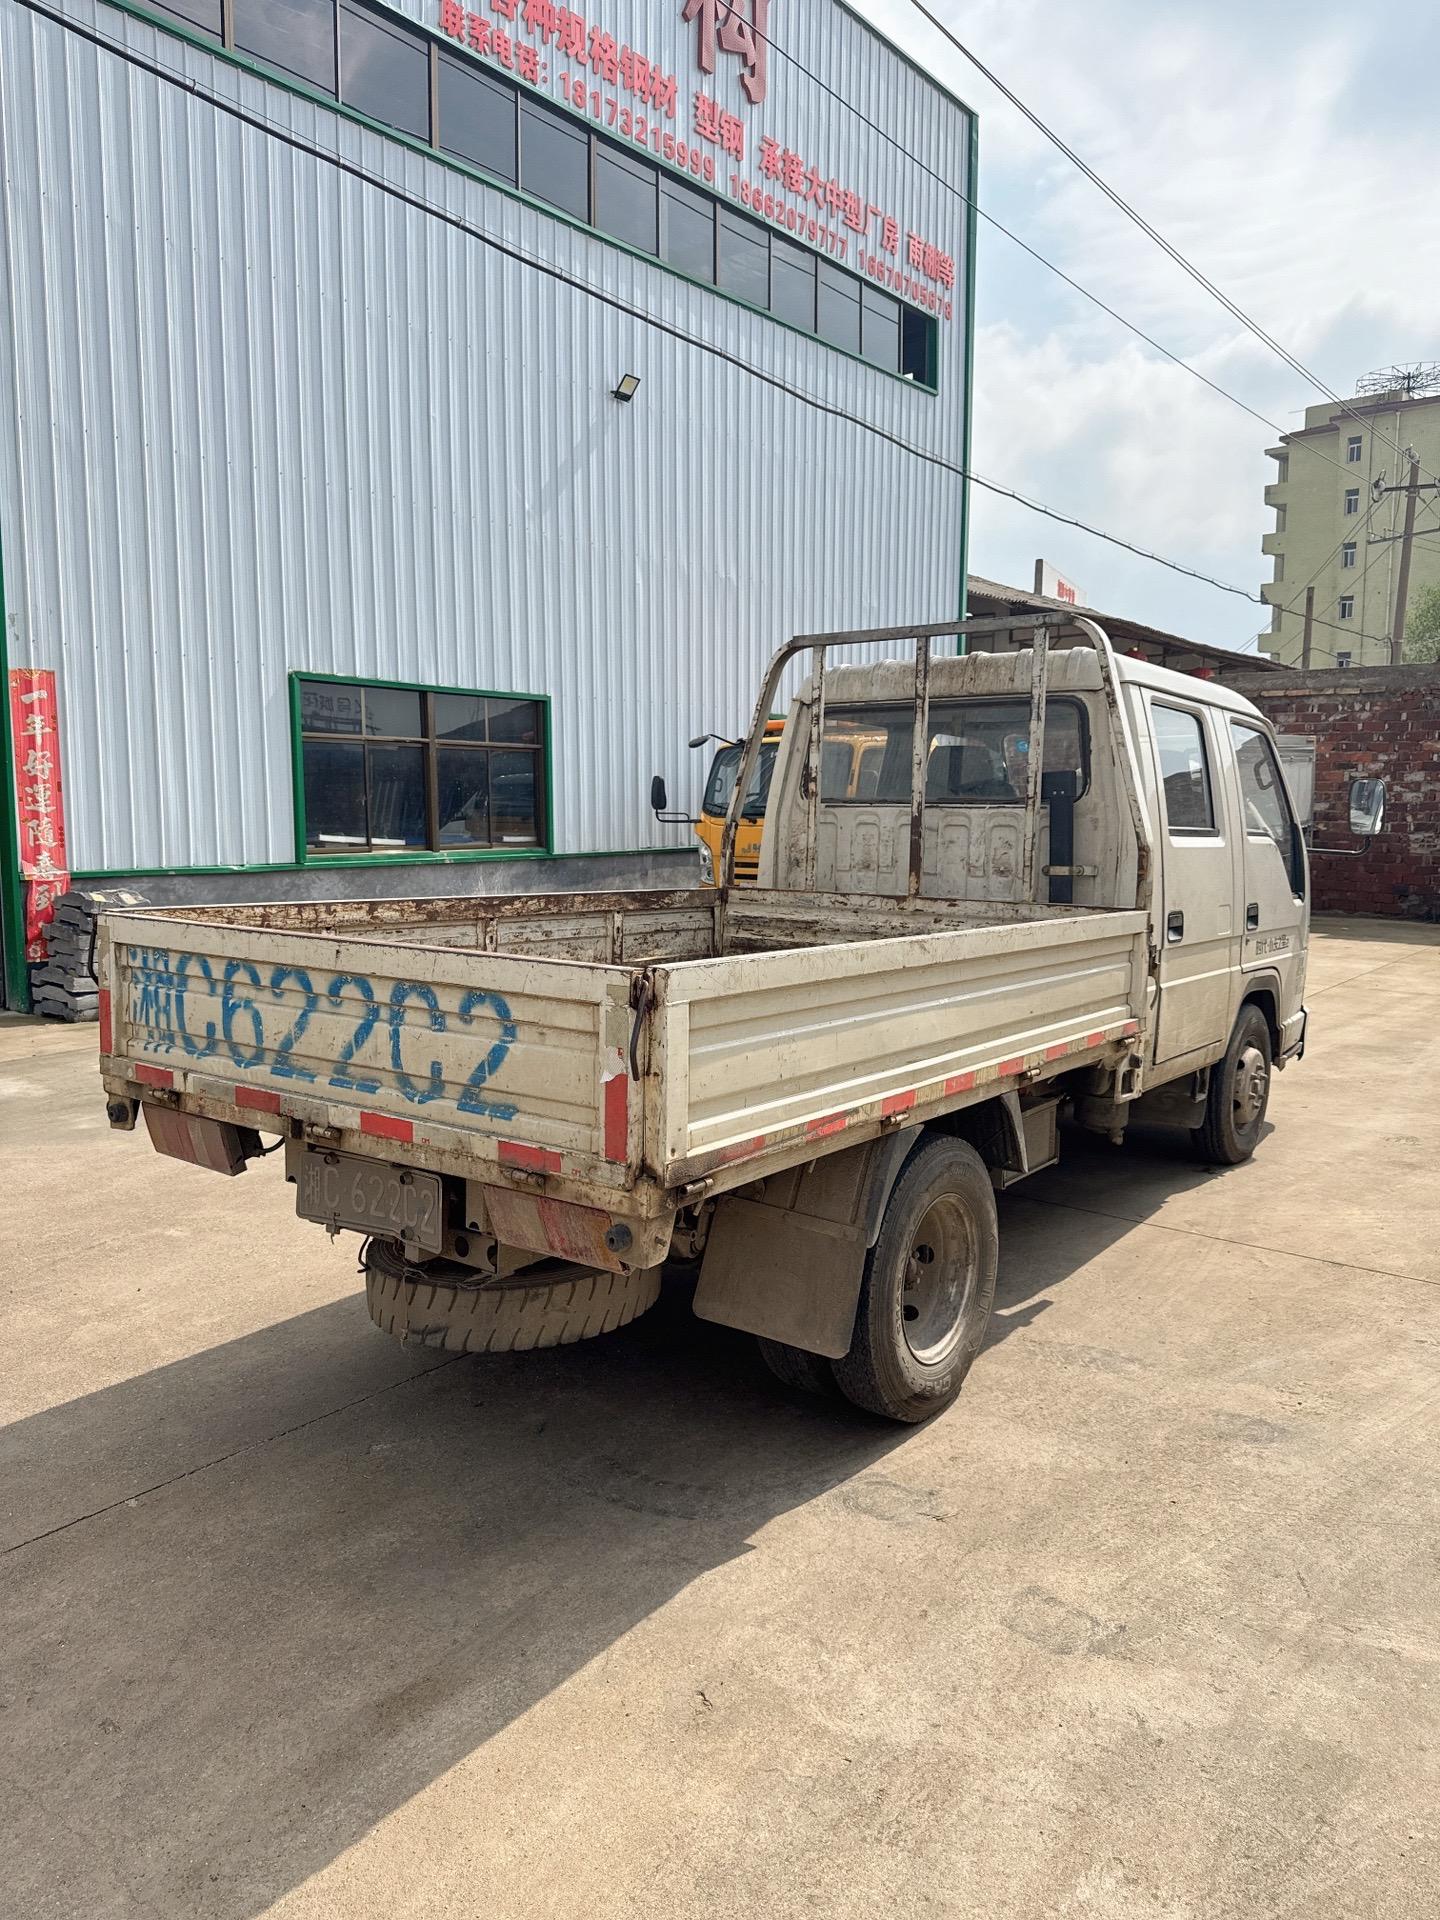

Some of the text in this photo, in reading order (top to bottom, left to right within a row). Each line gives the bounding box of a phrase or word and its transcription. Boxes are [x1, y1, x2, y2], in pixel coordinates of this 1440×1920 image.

[559, 71, 716, 182] 18173215999
[729, 174, 848, 258] 18662079777
[693, 90, 745, 162] 型钢
[758, 134, 898, 256] 承接大中型厂房
